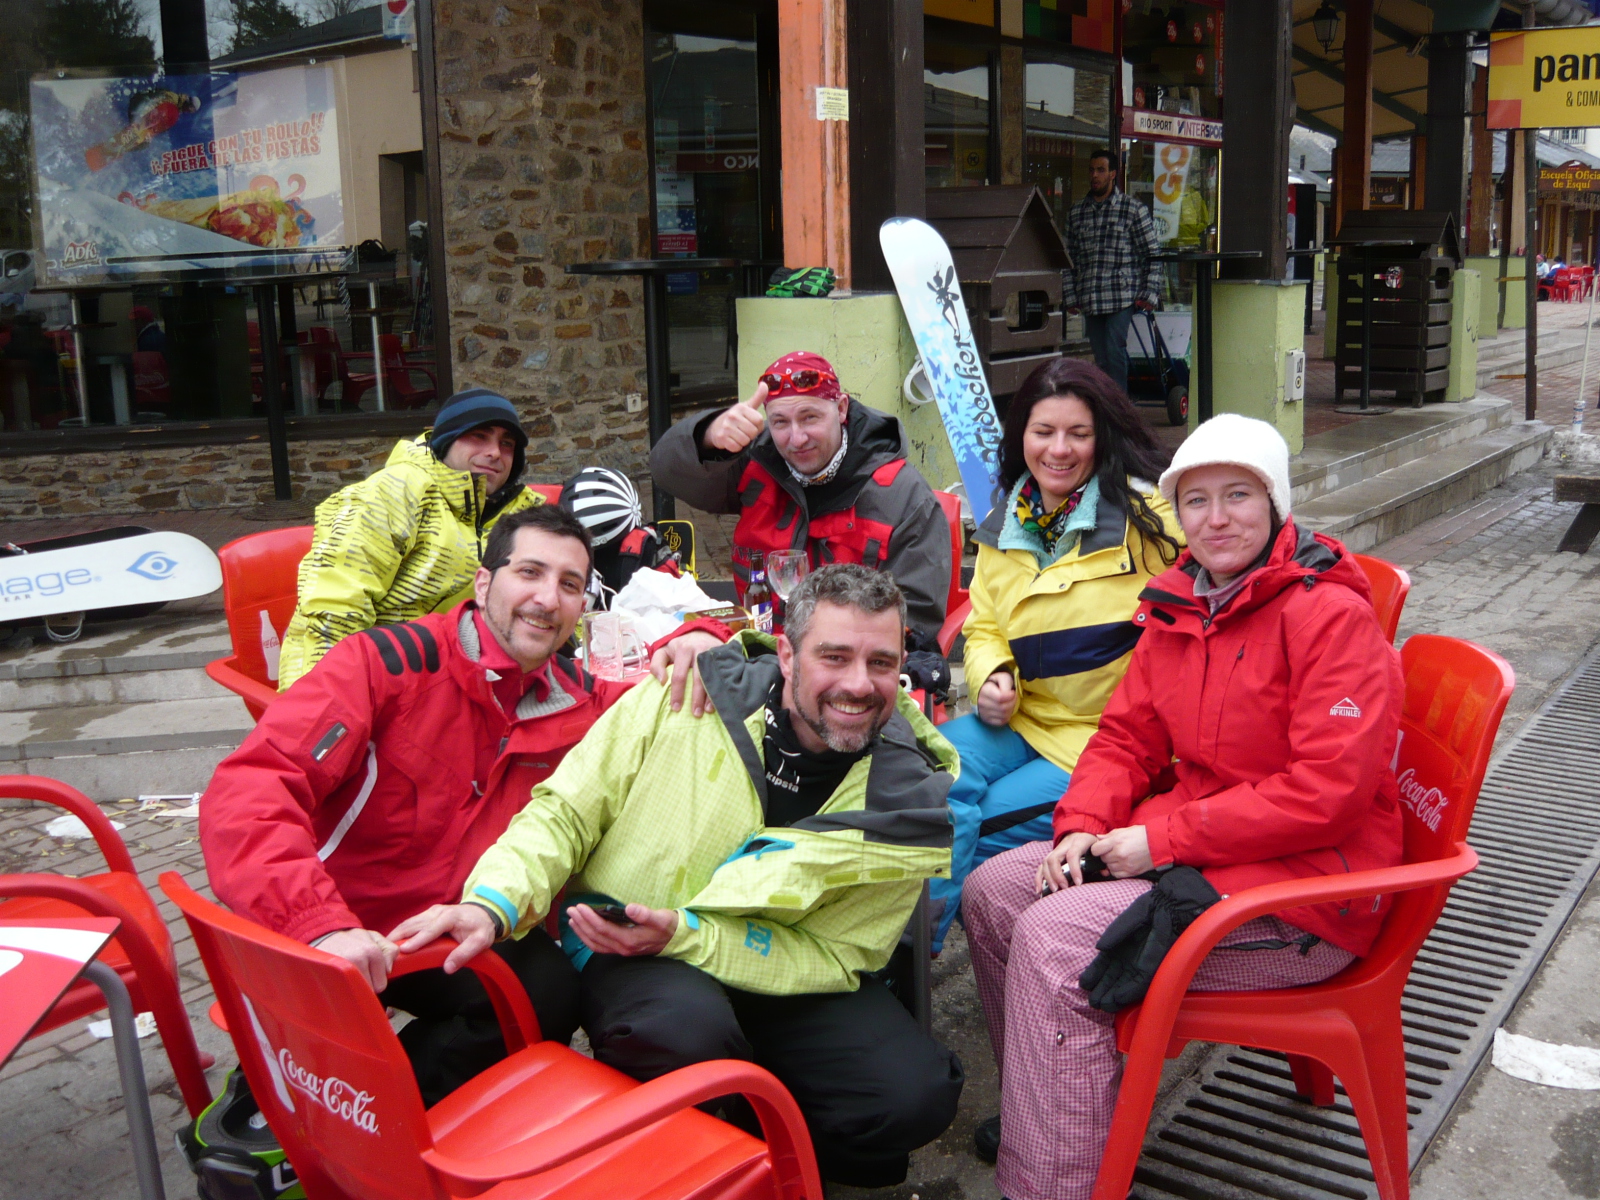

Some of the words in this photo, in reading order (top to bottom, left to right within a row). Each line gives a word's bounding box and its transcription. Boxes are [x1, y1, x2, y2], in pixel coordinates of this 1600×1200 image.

[1576, 90, 1600, 107] COM
[1140, 117, 1152, 128] RIO
[1152, 119, 1173, 131] SPORT
[162, 143, 205, 164] SIGUE
[208, 134, 239, 153] CON
[242, 129, 263, 146] TU
[214, 151, 230, 167] DE
[234, 145, 263, 164] LAS
[265, 135, 322, 160] PISTAS
[1540, 170, 1573, 180] Escuela
[1552, 179, 1564, 188] de
[1566, 179, 1592, 191] Esquí
[0, 568, 92, 597] age
[766, 771, 799, 793] kipsta
[278, 1048, 379, 1133] Coca-Cola
